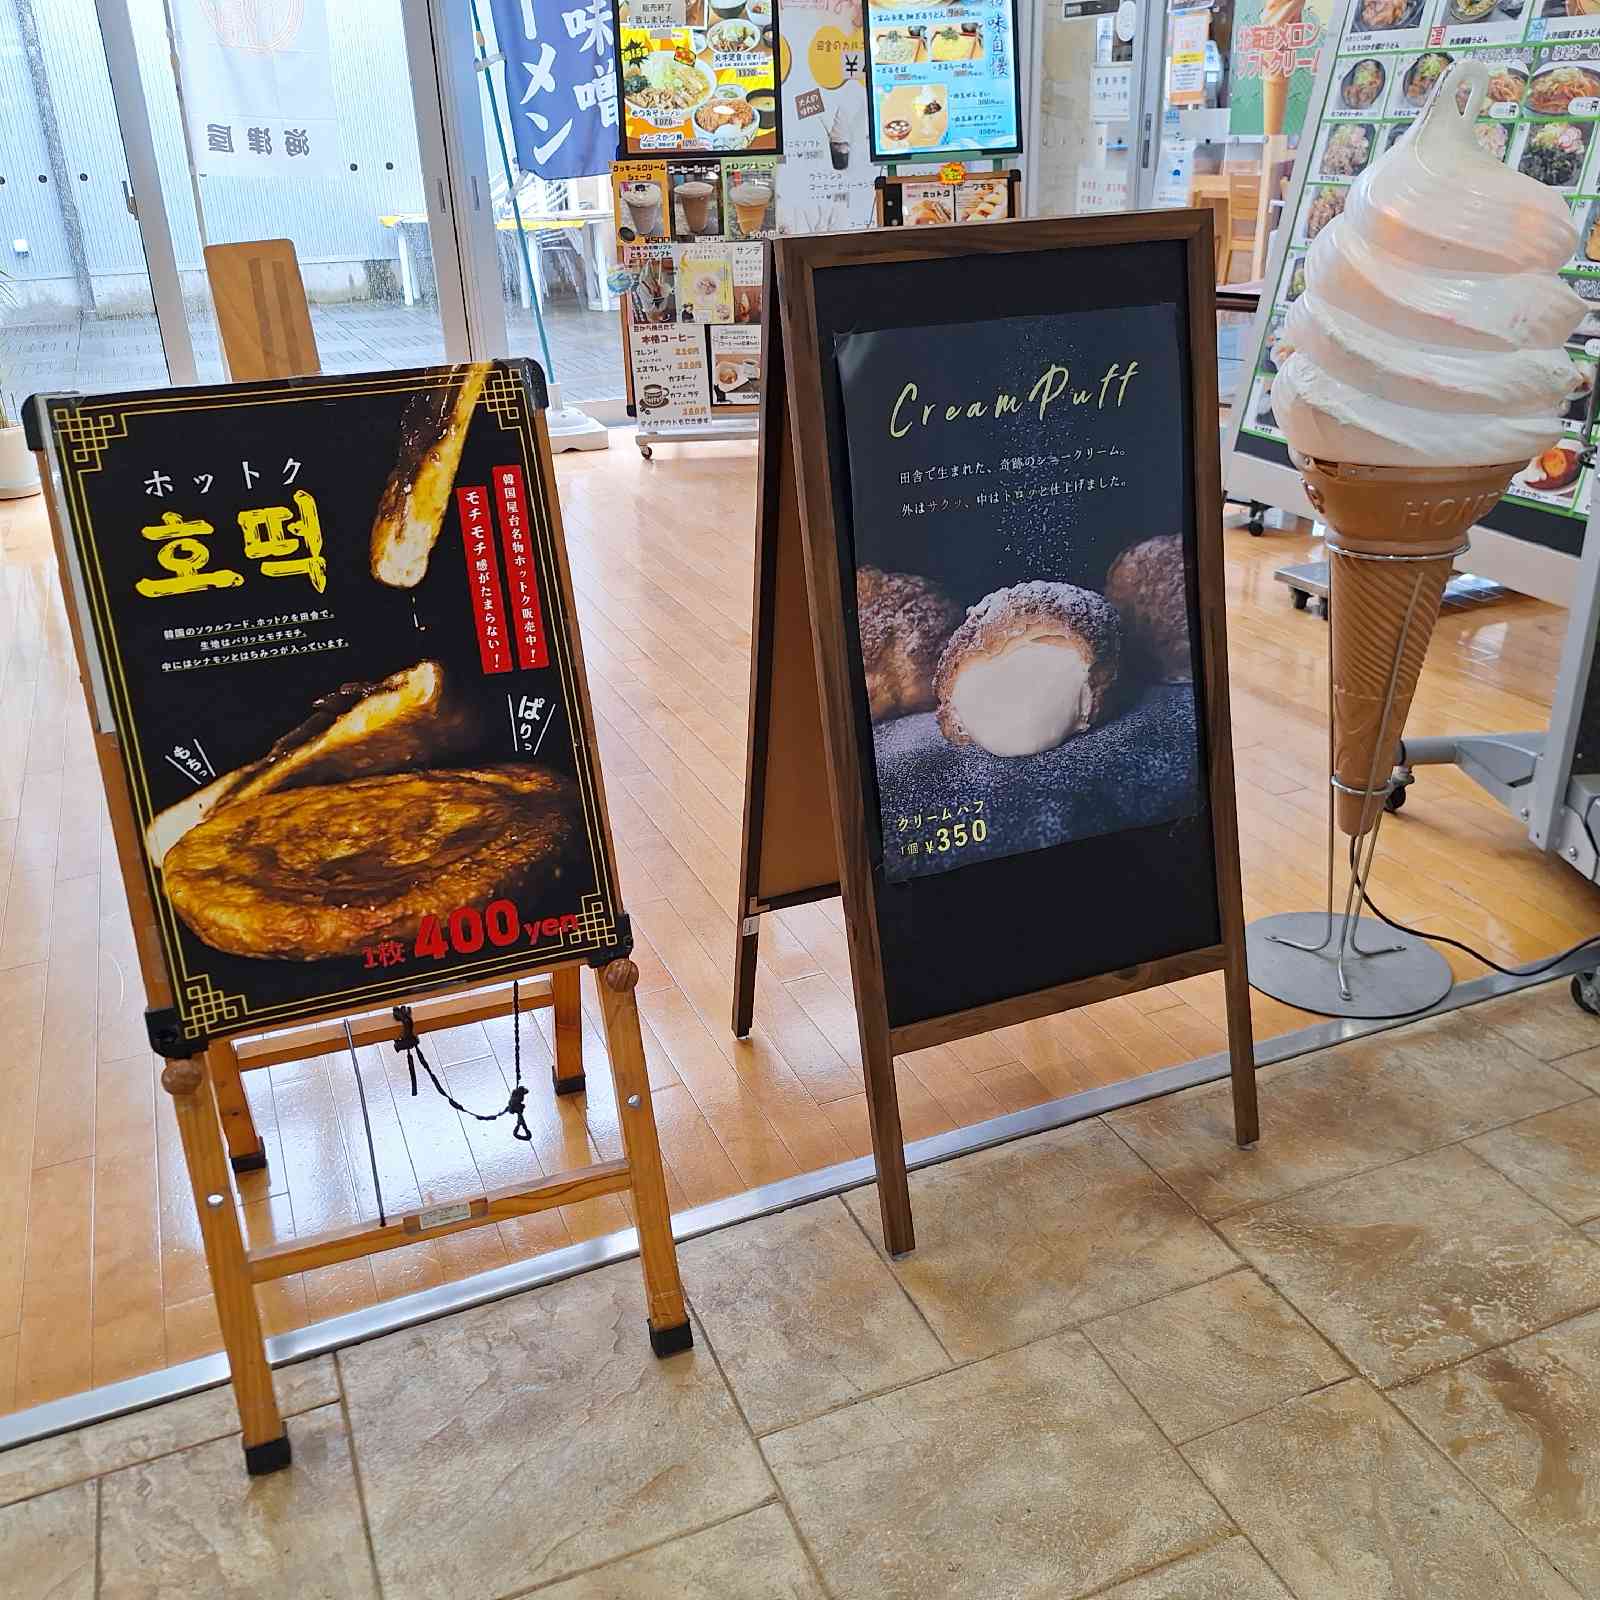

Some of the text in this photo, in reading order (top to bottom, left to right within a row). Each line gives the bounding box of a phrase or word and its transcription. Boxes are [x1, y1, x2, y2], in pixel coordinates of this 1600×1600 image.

[641, 333, 696, 345] 本格コーヒー
[889, 361, 1138, 438] Cream Puff
[143, 457, 302, 497] ホットク
[135, 489, 328, 598] 호떡
[363, 940, 405, 969] 1枚
